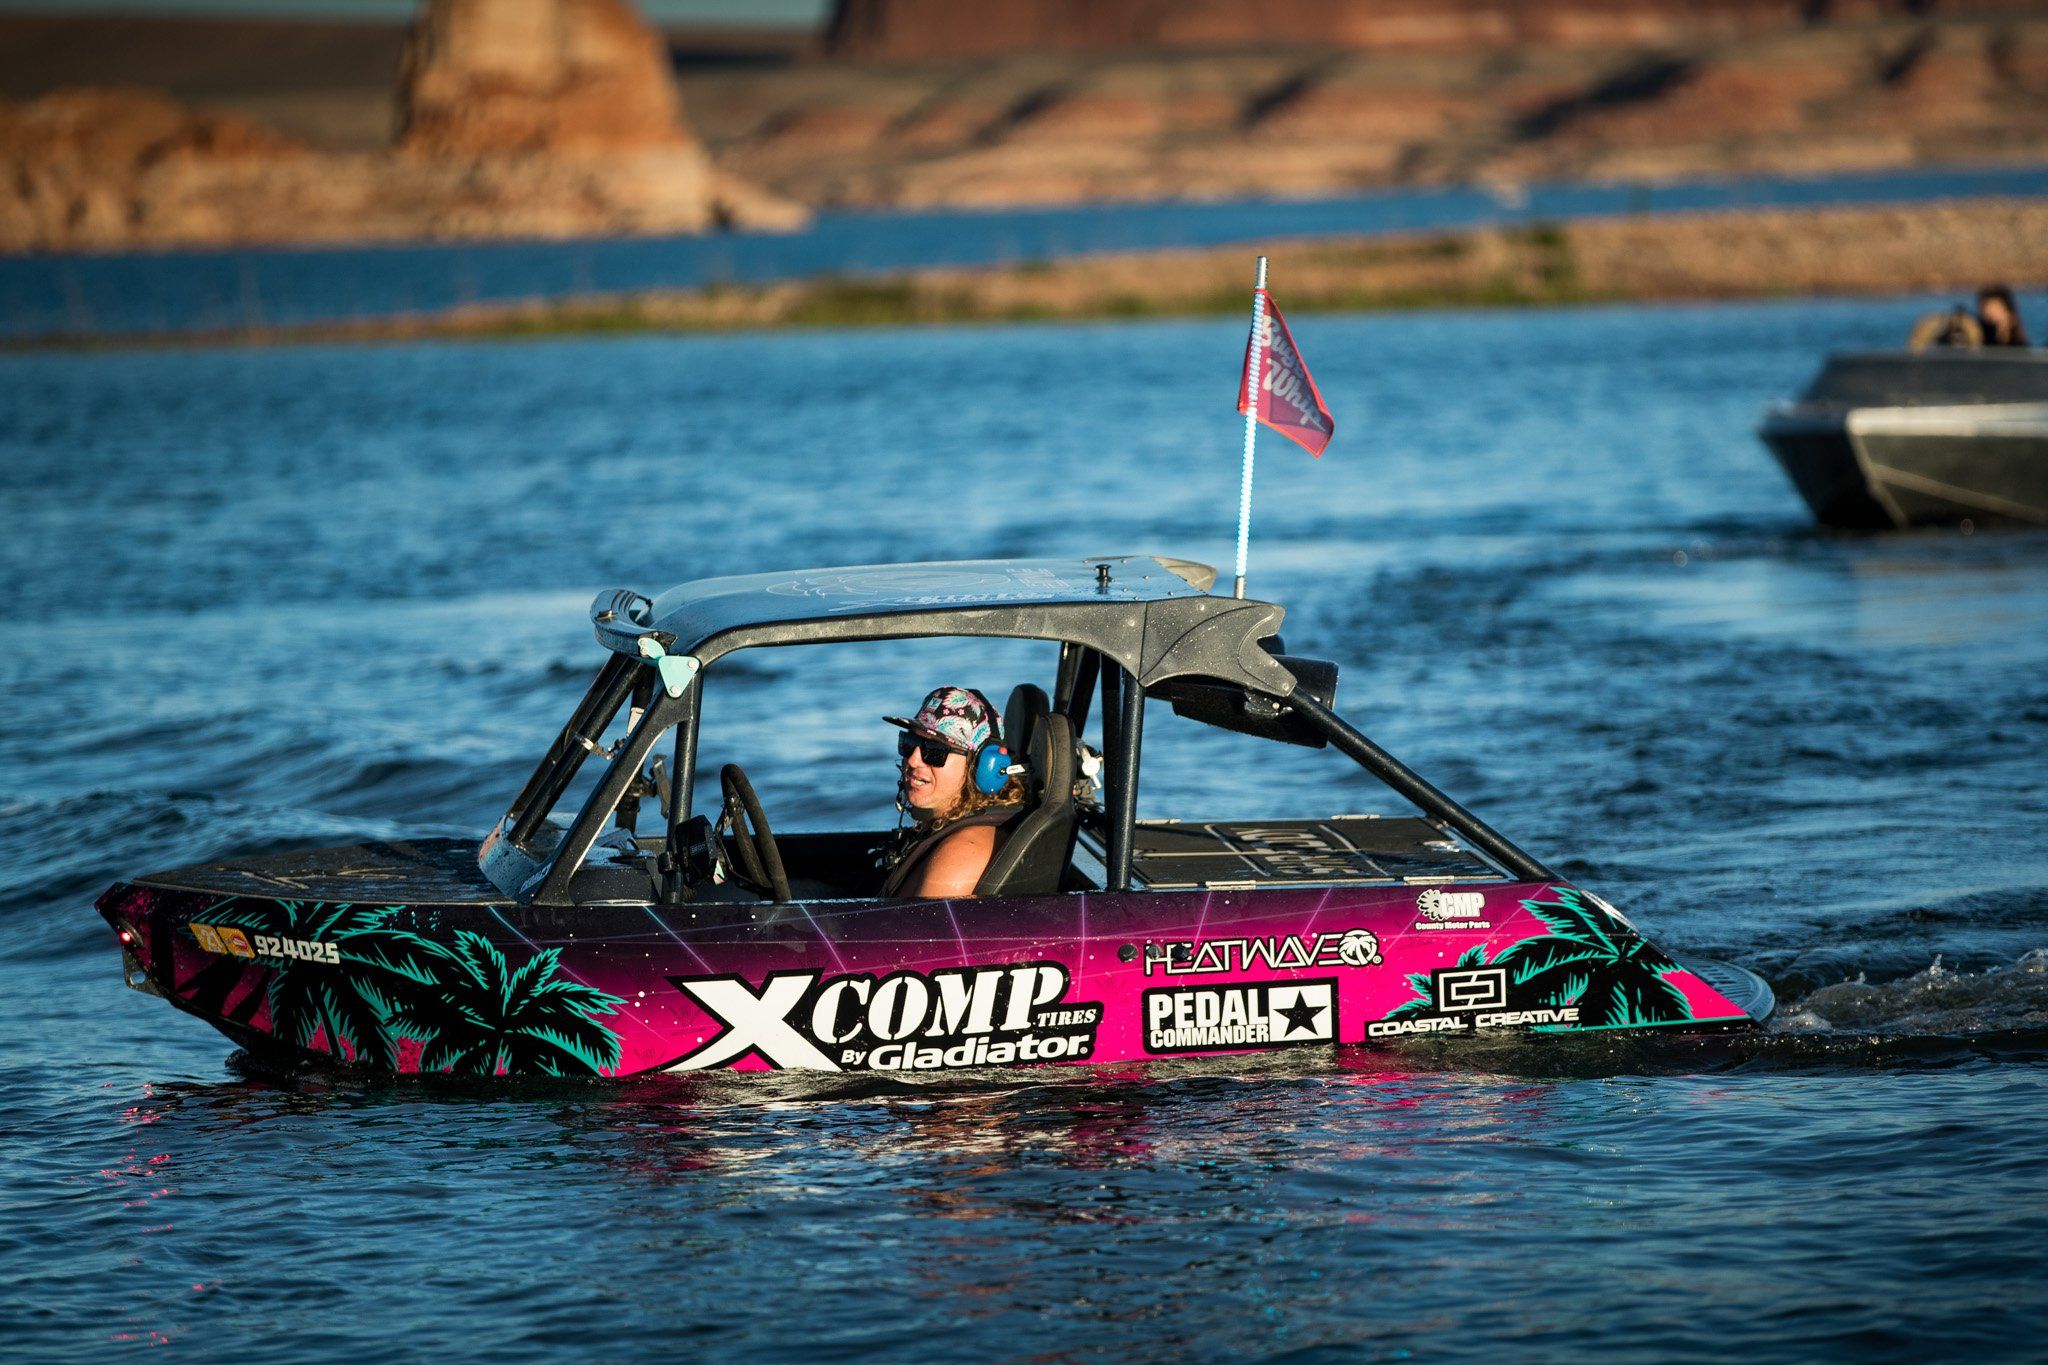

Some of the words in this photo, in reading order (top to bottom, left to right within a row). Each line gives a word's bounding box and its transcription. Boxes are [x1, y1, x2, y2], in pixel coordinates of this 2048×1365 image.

[1440, 892, 1486, 918] CMP
[1444, 921, 1468, 929] Motor
[1468, 921, 1491, 929] Parts
[254, 935, 340, 965] 924025
[1146, 933, 1344, 975] HEATWAVE
[1036, 1008, 1097, 1027] TIRES
[1150, 988, 1269, 1030] PEDAL
[1368, 1016, 1469, 1037] COASTAL
[1475, 1008, 1580, 1028] CREATIVE
[1150, 1024, 1270, 1048] COMMANDER
[841, 1049, 866, 1066] By
